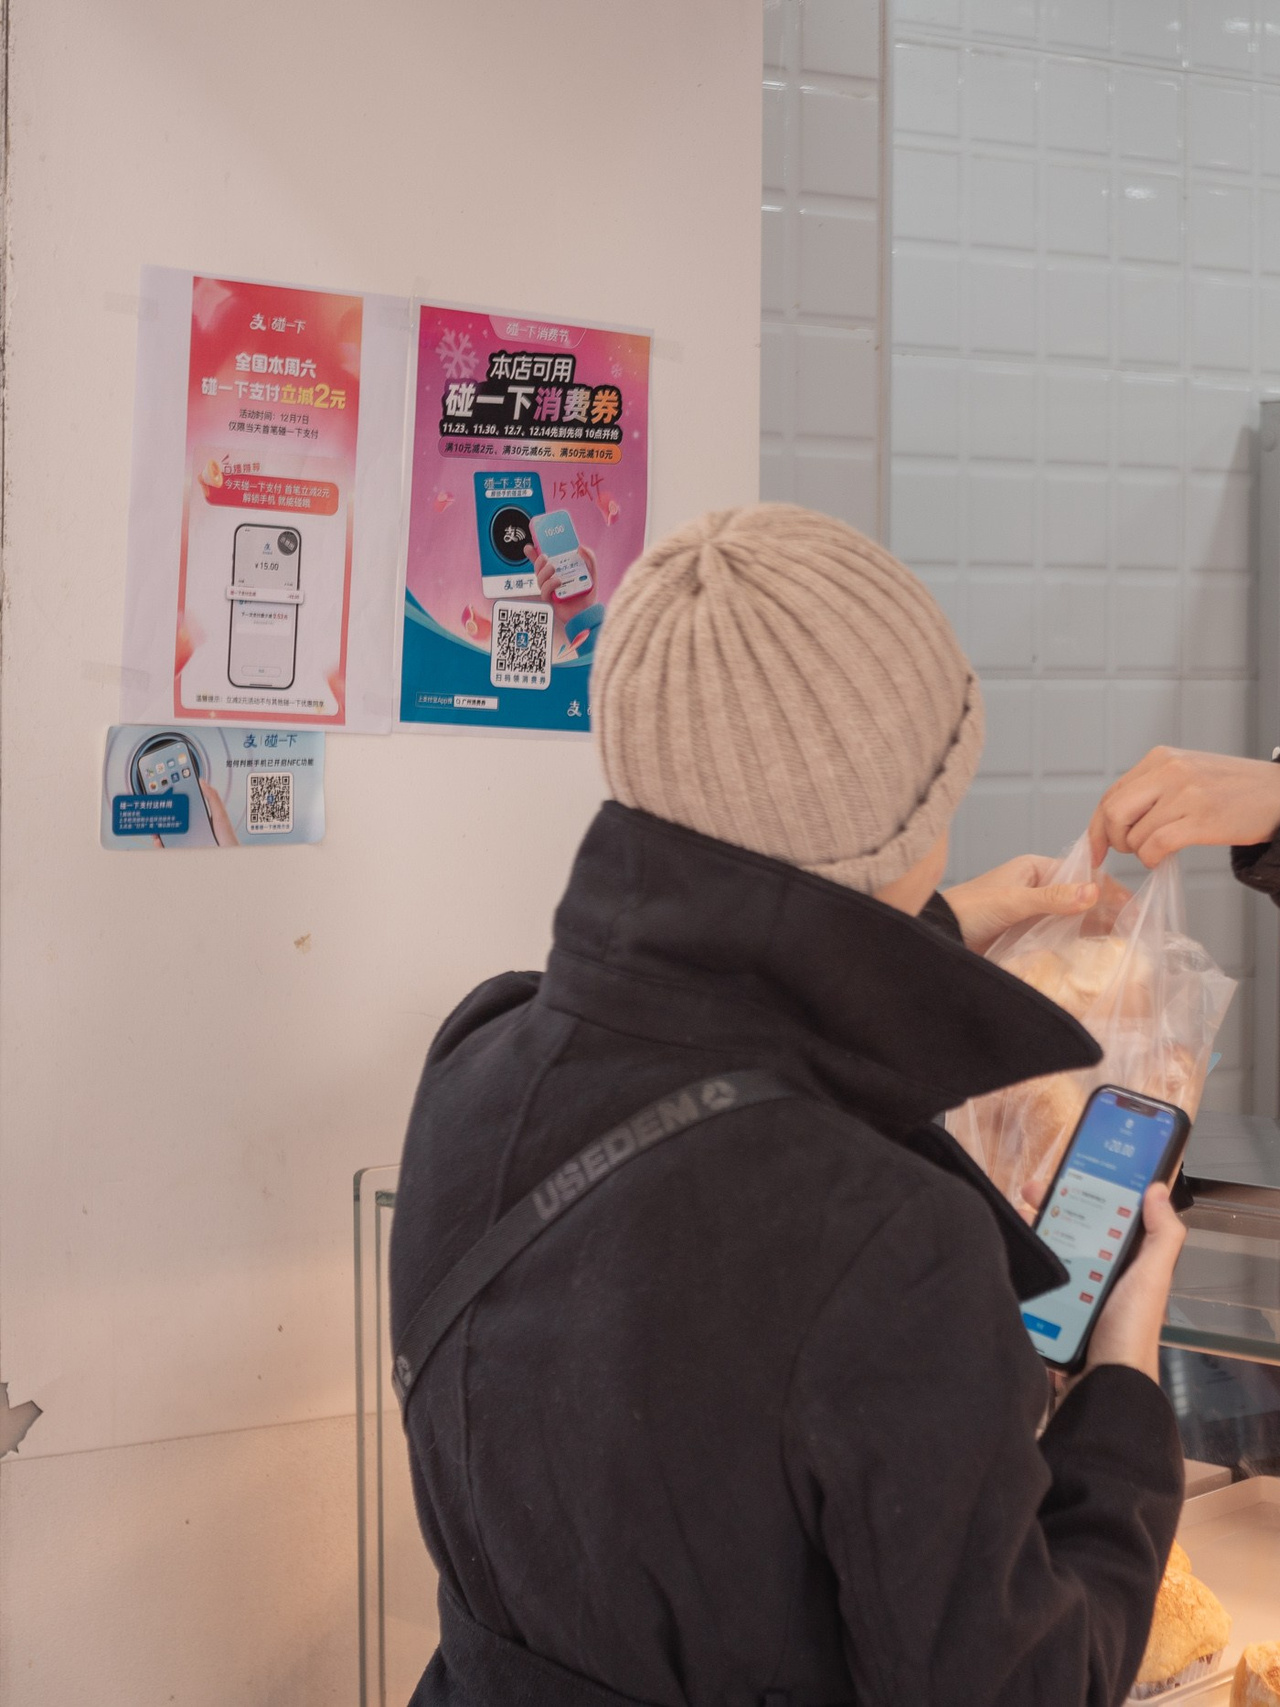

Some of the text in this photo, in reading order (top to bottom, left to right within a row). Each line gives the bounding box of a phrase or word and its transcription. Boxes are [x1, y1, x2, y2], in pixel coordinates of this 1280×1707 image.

[271, 316, 306, 334] 碰一下
[506, 322, 570, 344] 碰一下消费节
[235, 351, 316, 379] 全国本周六
[490, 355, 574, 383] 本店可用
[201, 375, 346, 410] 碰一下支付立减2元
[445, 382, 620, 424] 碰一下消费券
[228, 421, 319, 440] 仅限当天首笔碰一下支付
[585, 428, 620, 441] 10点开抢
[444, 441, 614, 460] 满10元减2元、满30元减6元、满50元减10元
[225, 479, 330, 498] 今天碰一下支付 首笔立减2元
[242, 493, 275, 506] 解锁手机
[544, 524, 565, 537] 10:00
[264, 733, 298, 748] 碰一下
[226, 757, 314, 769] 如何判断手机已开启NFC功能
